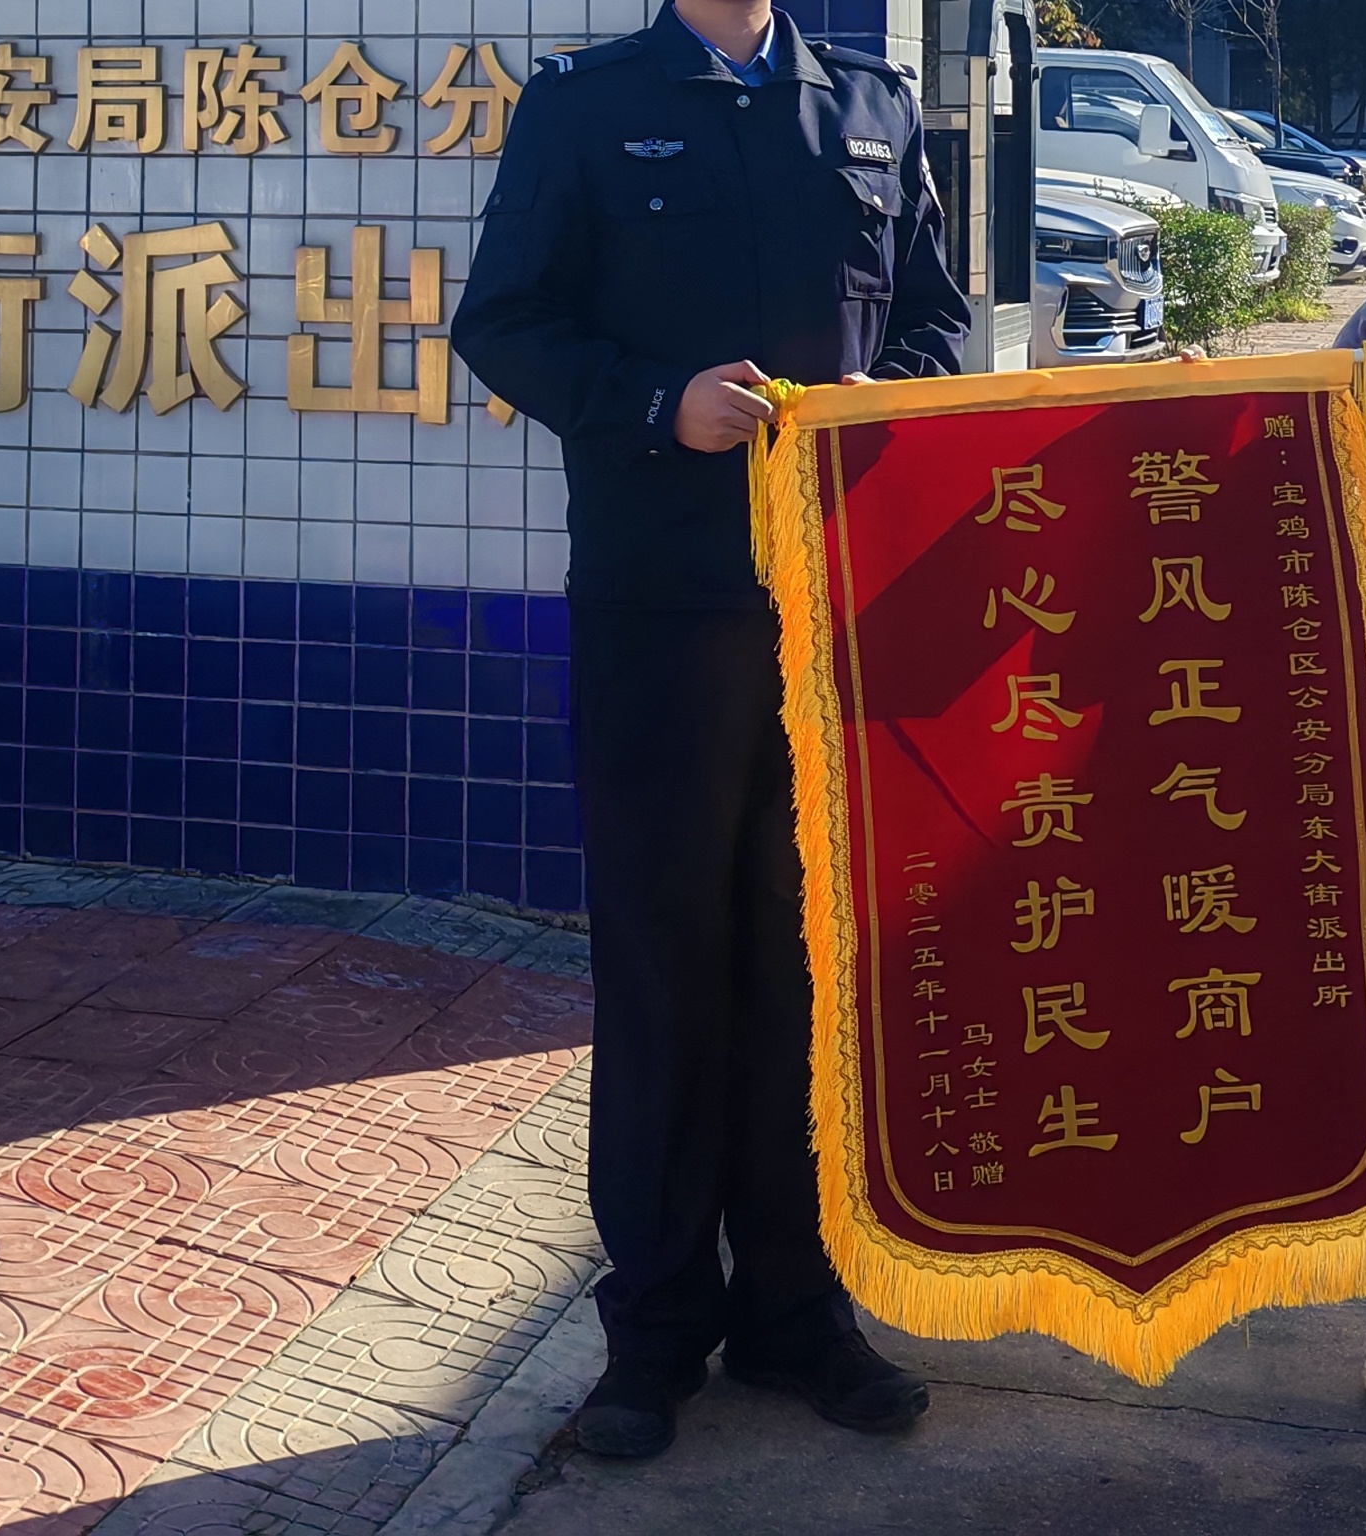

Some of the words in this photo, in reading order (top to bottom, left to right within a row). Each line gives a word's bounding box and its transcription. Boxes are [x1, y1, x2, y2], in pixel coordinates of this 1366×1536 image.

[849, 140, 893, 159] 024463
[646, 388, 666, 425] POLICE
[974, 463, 1119, 1158] 尽心尽责护民生
[1129, 448, 1263, 1145] 警风正气暖商户
[902, 850, 960, 1193] 二零二五年十一月十八日
